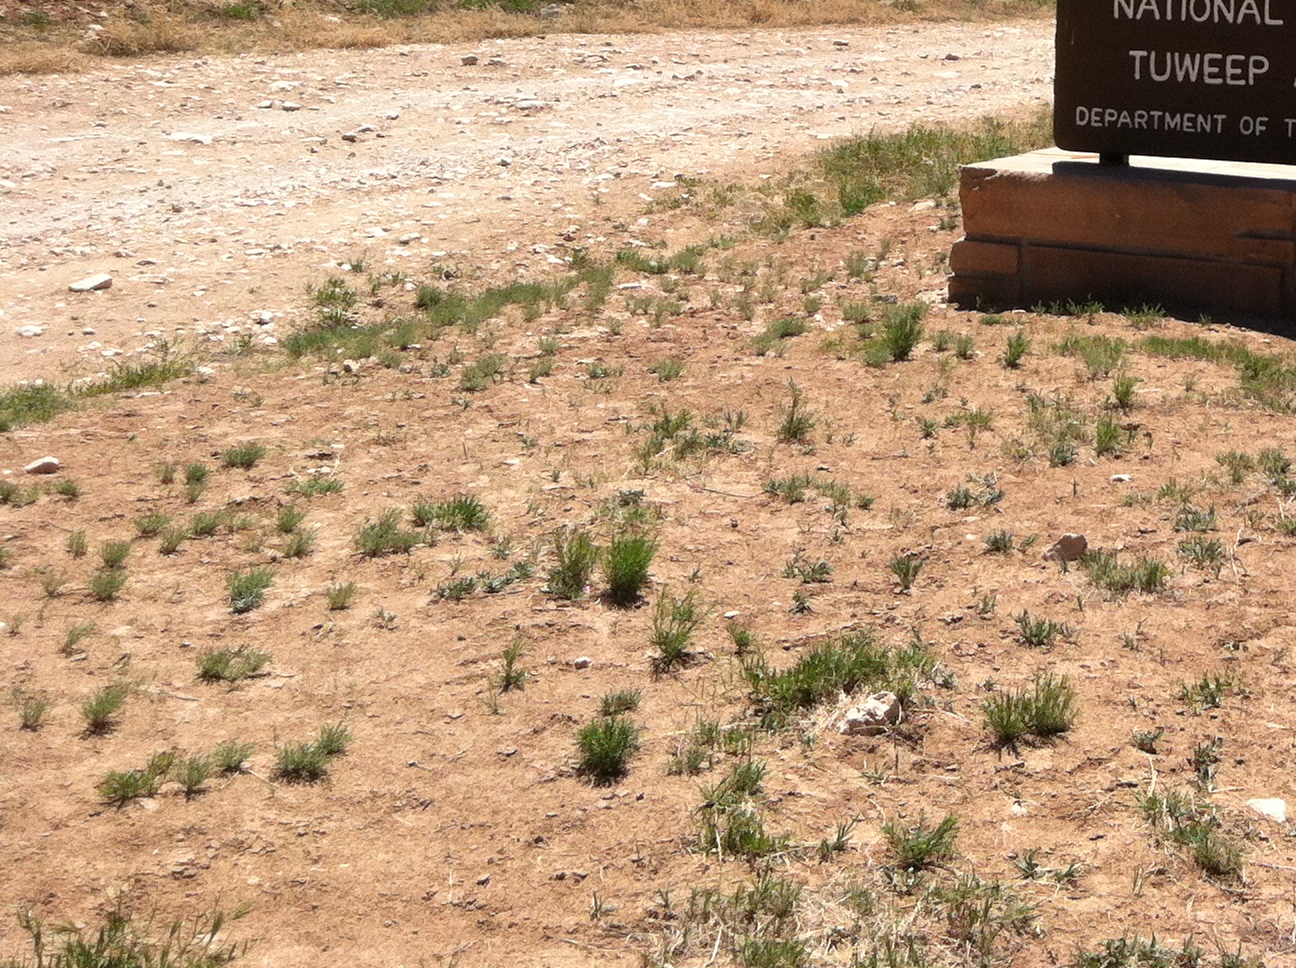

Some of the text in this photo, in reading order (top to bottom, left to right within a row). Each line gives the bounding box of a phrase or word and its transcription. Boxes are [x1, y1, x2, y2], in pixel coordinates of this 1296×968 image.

[1129, 50, 1270, 86] TUWEEP
[1075, 106, 1227, 134] DEPARTMENT
[1239, 116, 1269, 136] OF
